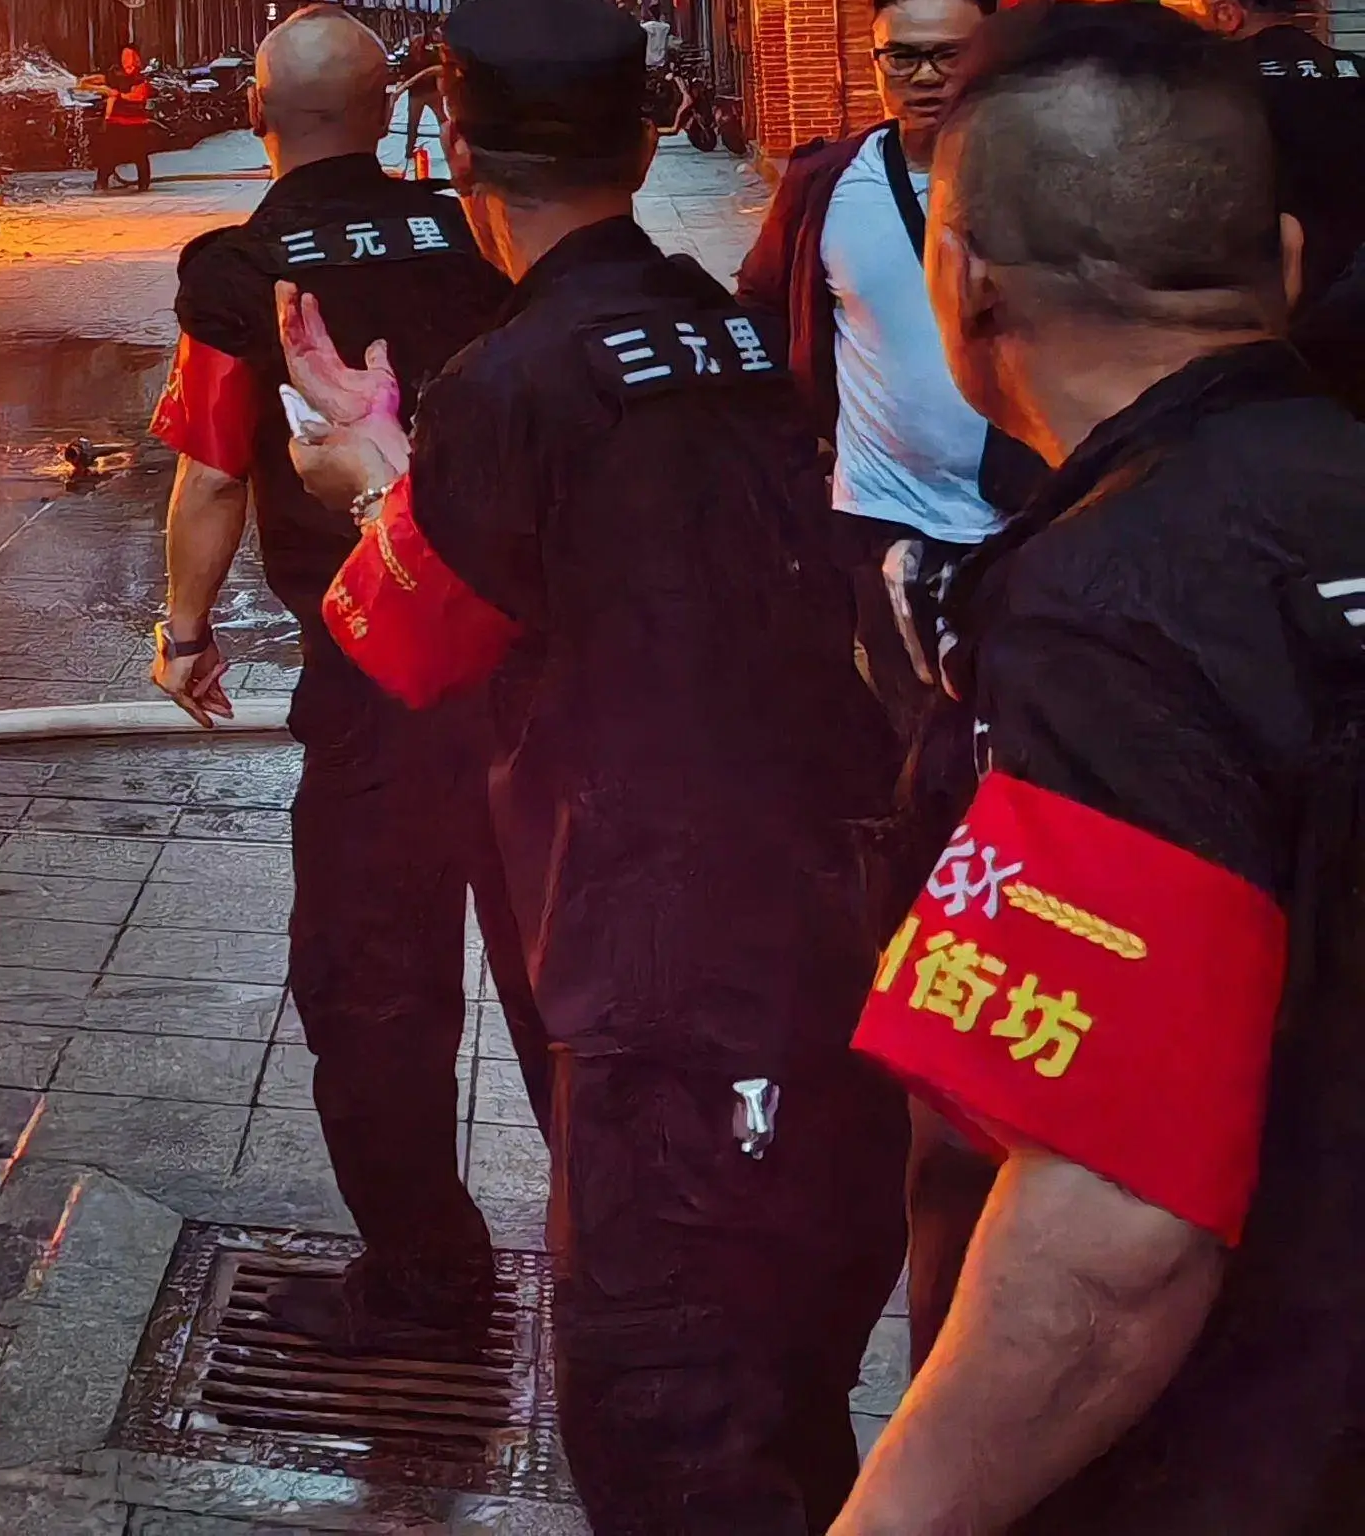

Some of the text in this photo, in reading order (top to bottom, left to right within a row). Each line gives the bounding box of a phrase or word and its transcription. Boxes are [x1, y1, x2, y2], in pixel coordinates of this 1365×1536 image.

[280, 216, 450, 264] 三元里
[601, 316, 774, 385] 三元里
